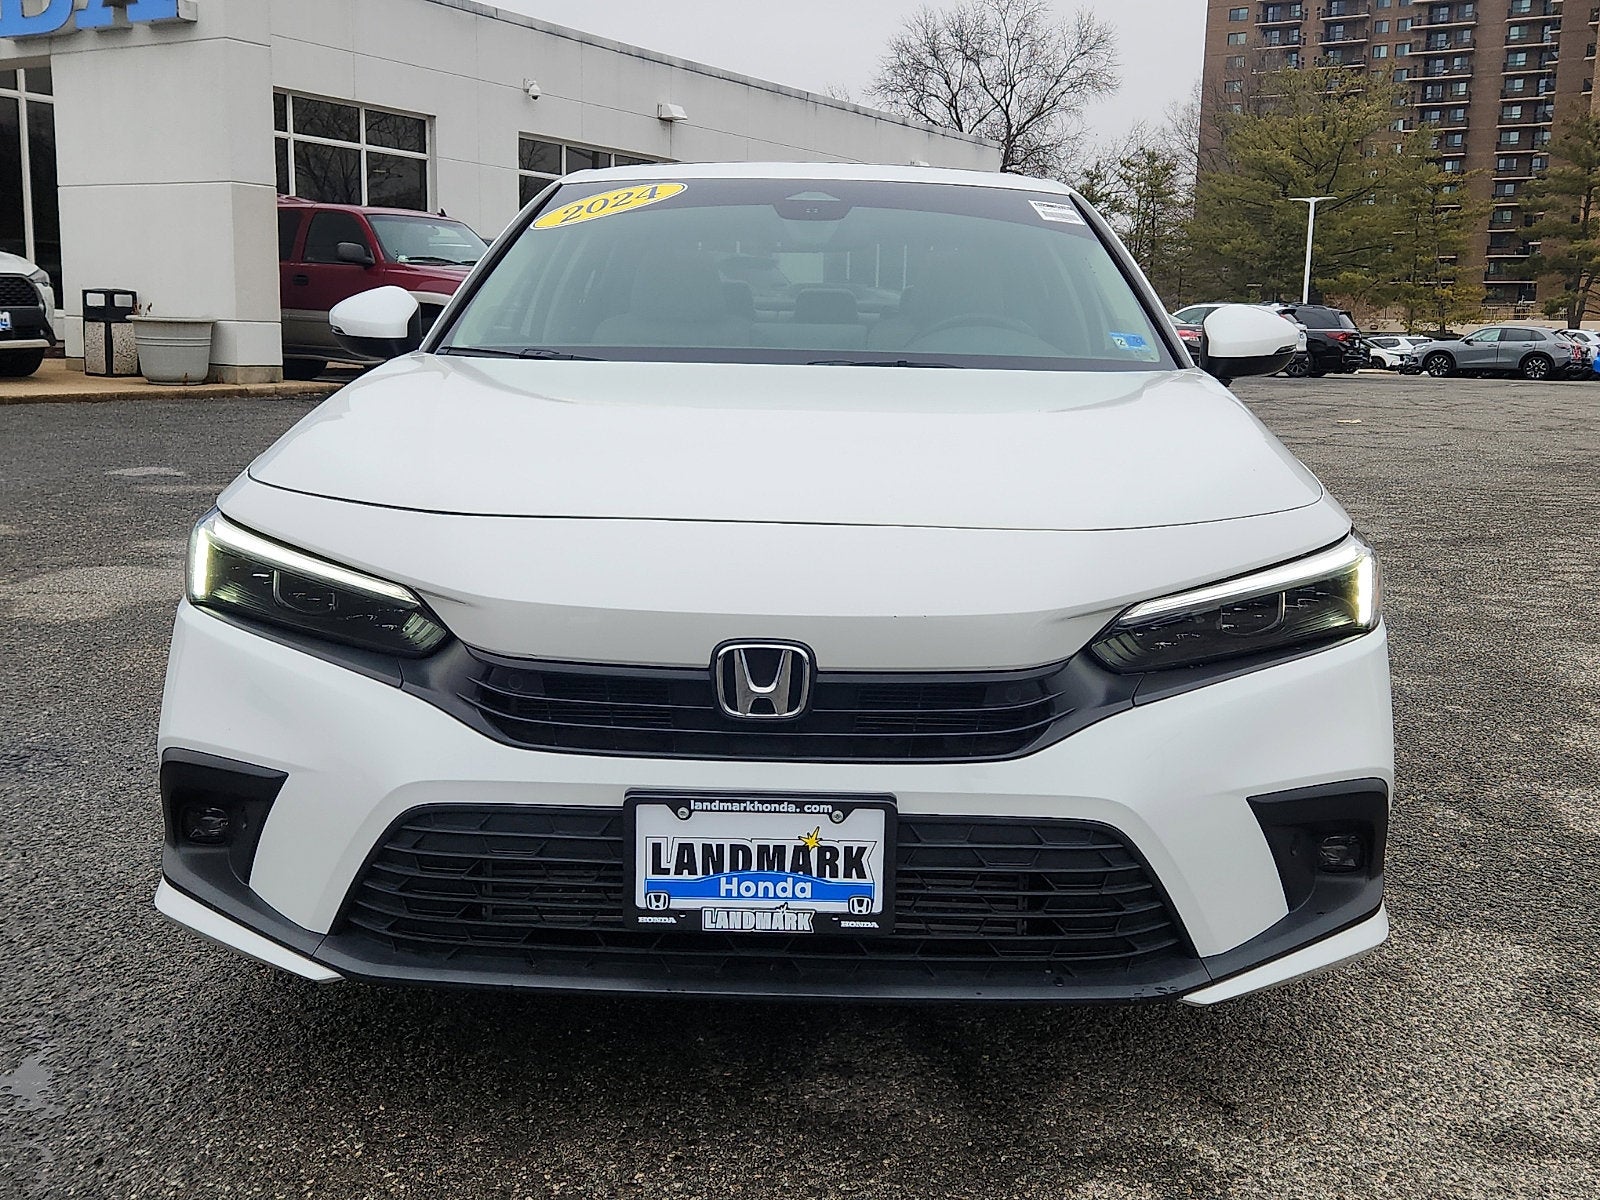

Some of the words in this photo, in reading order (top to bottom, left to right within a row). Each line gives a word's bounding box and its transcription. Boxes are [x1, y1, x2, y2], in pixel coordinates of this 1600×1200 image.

[560, 185, 661, 224] 2024
[804, 804, 833, 813] com
[651, 842, 868, 880] LANDMARK
[720, 878, 812, 899] Honda
[638, 916, 677, 924] HONDA
[704, 911, 811, 931] LANDMARK
[840, 921, 880, 929] HONDA
